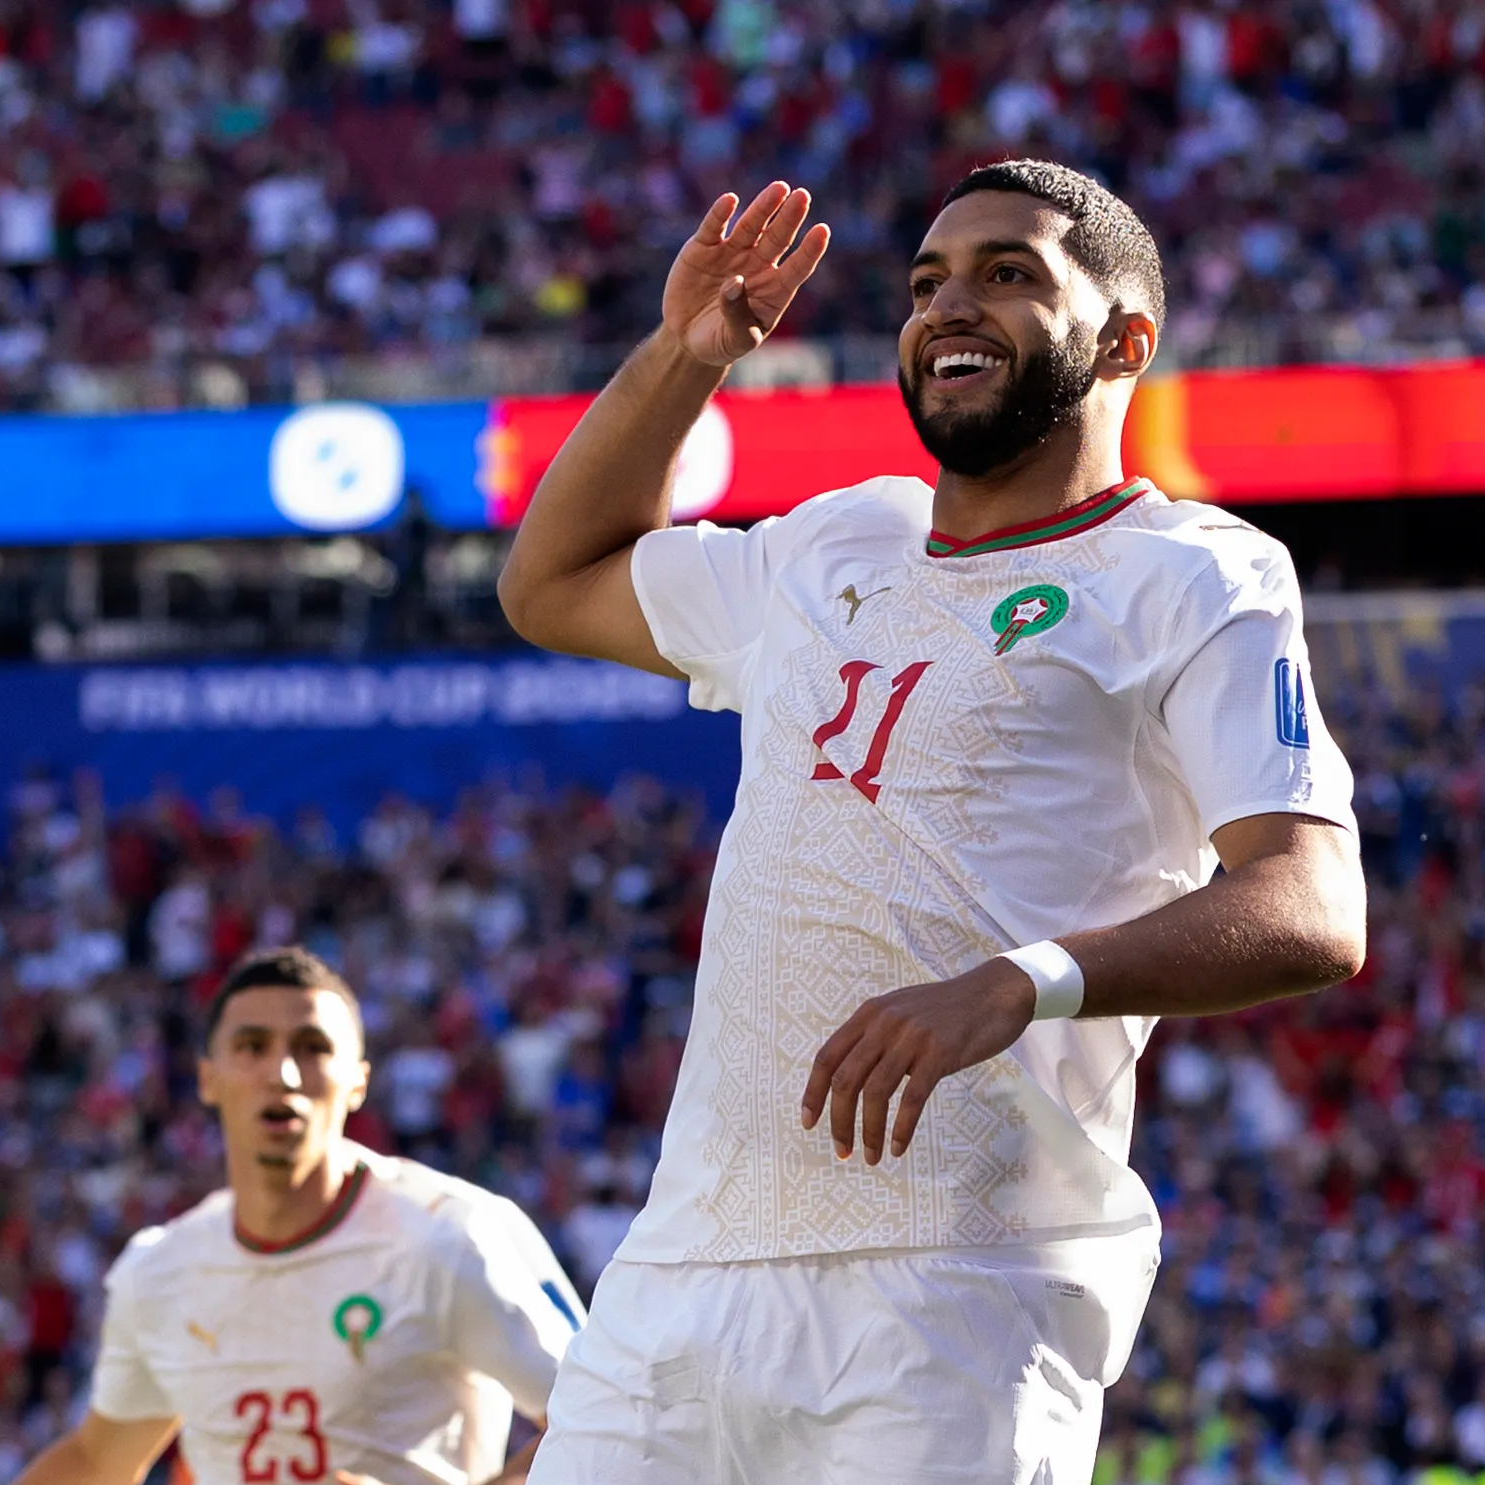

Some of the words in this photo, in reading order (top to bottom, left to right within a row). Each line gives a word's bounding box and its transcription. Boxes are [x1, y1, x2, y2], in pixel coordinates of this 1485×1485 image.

[83, 670, 193, 728] FIFA
[200, 668, 382, 727] WORLD
[389, 666, 491, 726] CUP
[235, 1389, 327, 1484] 23
